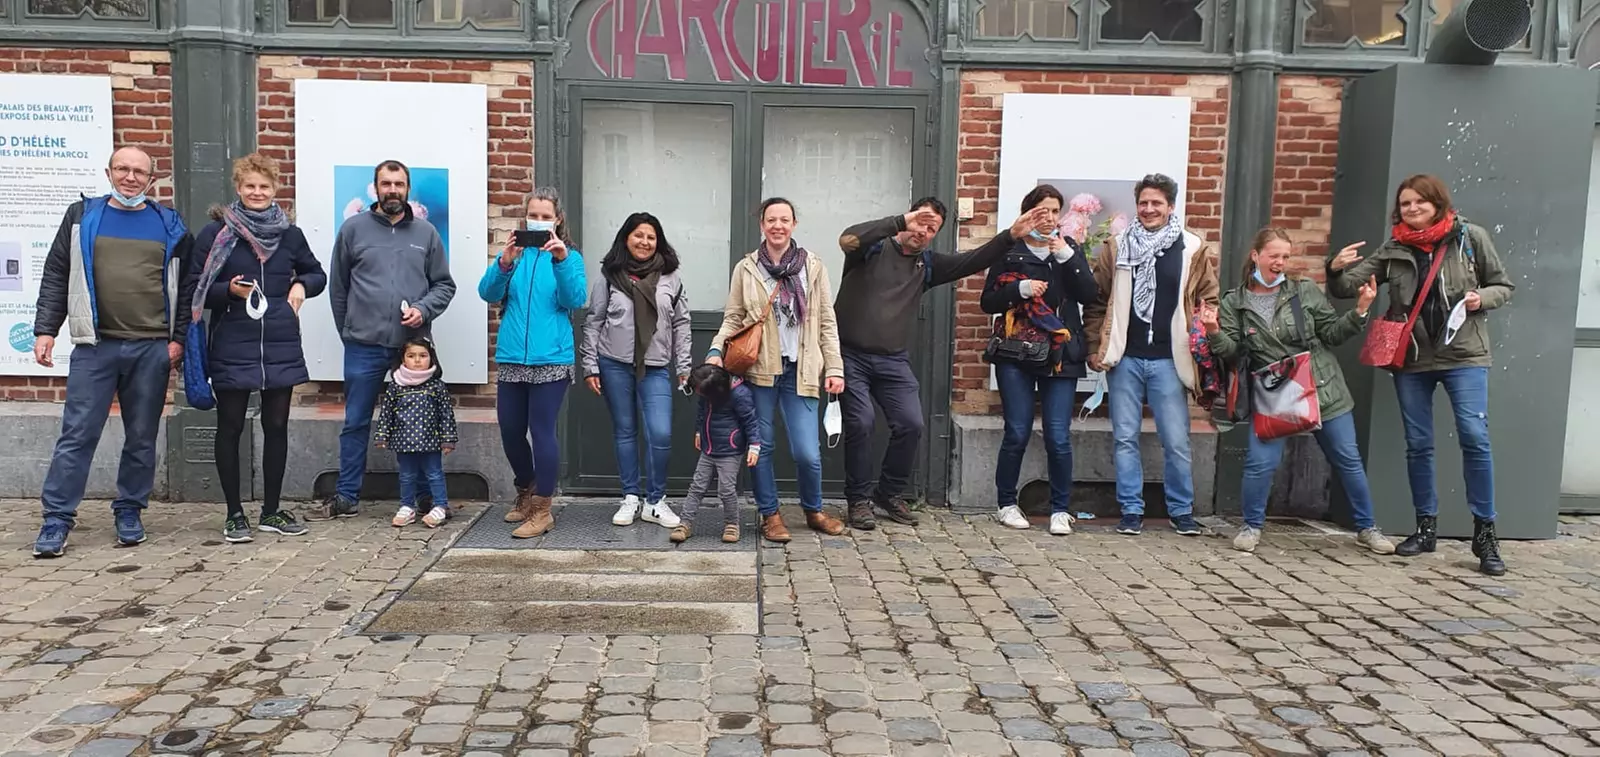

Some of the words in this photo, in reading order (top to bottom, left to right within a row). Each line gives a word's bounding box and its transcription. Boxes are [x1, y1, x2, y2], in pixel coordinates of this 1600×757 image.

[27, 104, 42, 112] DES
[44, 104, 94, 114] BEAUX-ARTS
[33, 113, 55, 121] DANS
[57, 113, 67, 121] LA
[69, 114, 88, 122] VILLE
[53, 151, 89, 159] MARCOZ
